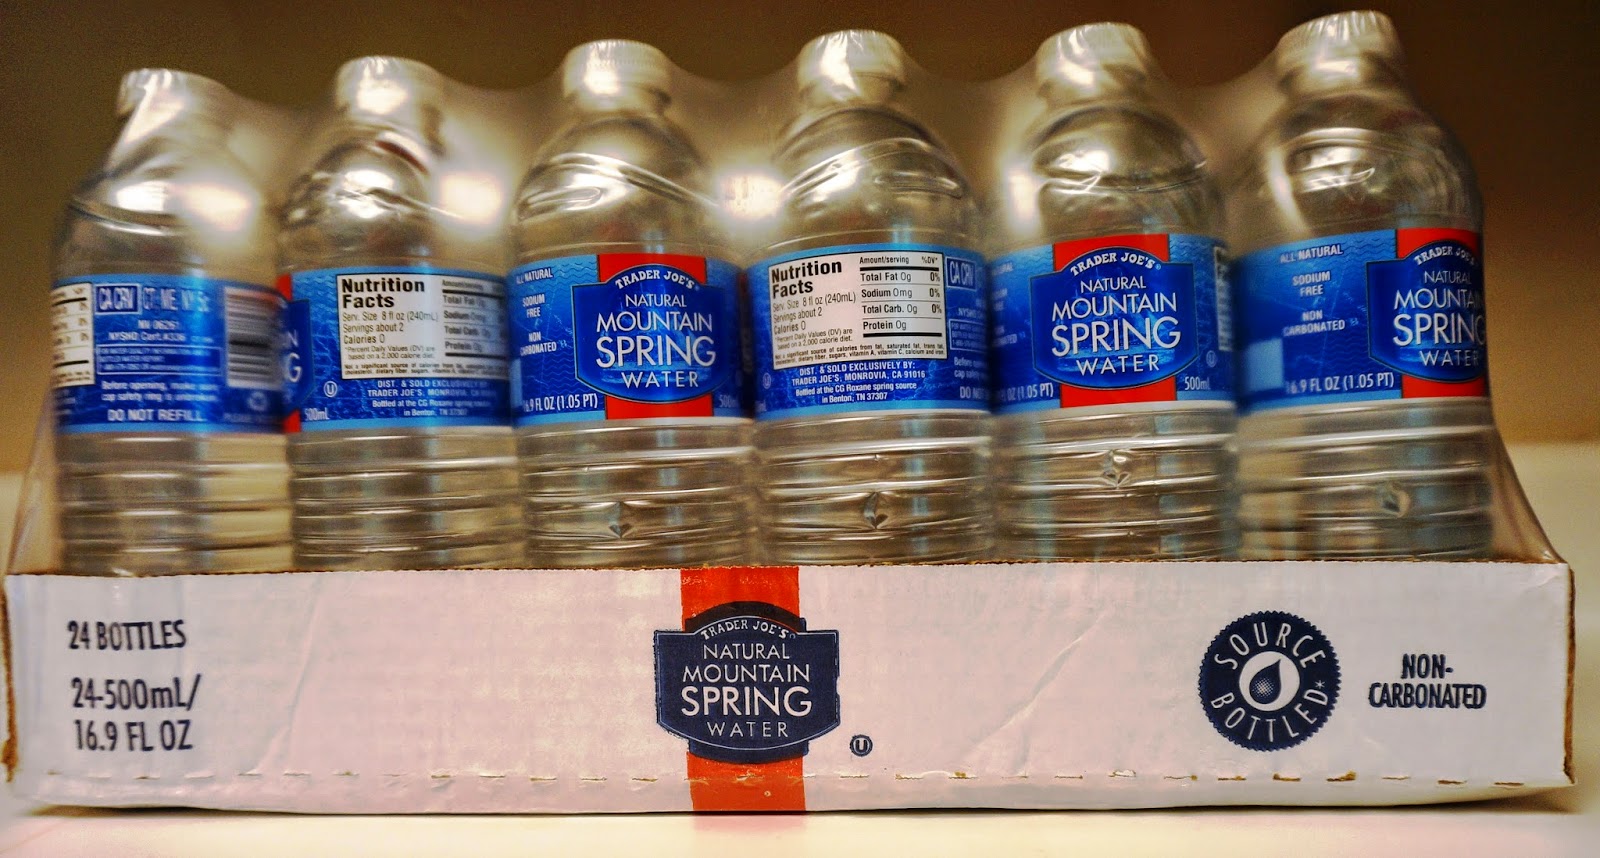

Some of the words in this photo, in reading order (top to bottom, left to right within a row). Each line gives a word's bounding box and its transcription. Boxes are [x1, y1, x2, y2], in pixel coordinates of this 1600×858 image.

[859, 256, 910, 265] Amount/serving
[1280, 251, 1298, 264] ALL
[1298, 244, 1344, 261] NATURAL
[1413, 246, 1453, 266] TRADER
[771, 260, 842, 284] Nutrition
[1069, 252, 1117, 277] TRADER
[1120, 251, 1155, 270] JOE'S
[524, 267, 553, 282] NATURAL
[615, 269, 661, 290] TRADER
[663, 270, 695, 290] JOE'S
[860, 272, 882, 281] Total
[885, 272, 898, 281] Fat
[900, 271, 912, 282] 0g
[930, 272, 940, 282] 0%
[949, 260, 960, 285] CA
[1292, 270, 1331, 286] SODIUM
[1424, 270, 1472, 285] NATURAL
[341, 277, 425, 293] Nutrition
[772, 280, 813, 299] Facts
[861, 289, 891, 298] Sodium
[893, 287, 913, 298] 0mg
[929, 287, 940, 298] 0%
[1080, 275, 1147, 294] NATURAL
[1300, 284, 1324, 297] FREE
[342, 294, 395, 309] Facts
[522, 293, 546, 307] SODIUM
[625, 293, 687, 308] NATURAL
[786, 299, 800, 309] Size
[802, 296, 807, 307] 8
[808, 295, 814, 306] fl
[814, 296, 823, 306] oz
[824, 291, 857, 307] (240mL)
[1051, 292, 1178, 322] MOUNTAIN
[362, 311, 378, 321] Size
[381, 311, 387, 321] 8
[396, 312, 405, 321] oz
[406, 310, 439, 322] (240mL)
[526, 306, 541, 318] FREE
[773, 312, 797, 324] Servings
[797, 308, 817, 319] about
[817, 306, 823, 317] 2
[862, 305, 882, 314] Total
[883, 304, 905, 313] Carb.
[906, 303, 918, 314] 0g
[931, 303, 942, 314] 0%
[1302, 309, 1323, 321] NON
[343, 323, 374, 334] Servings
[375, 323, 397, 332] about
[399, 322, 404, 332] 2
[596, 311, 713, 333] MOUNTAIN
[774, 322, 799, 335] Calories
[800, 320, 807, 331] 0
[863, 320, 893, 330] Protein
[895, 320, 907, 331] 0g
[1283, 320, 1345, 337] CARBONATED
[343, 335, 377, 344] Calories
[379, 333, 386, 344] 0
[528, 331, 542, 342] NON
[1051, 315, 1182, 357] SPRING
[520, 341, 557, 356] CARBONATED
[596, 334, 716, 368] SPRING
[849, 349, 870, 357] vitamin
[1075, 353, 1160, 376] WATER
[1419, 349, 1480, 367] WATER
[799, 366, 818, 376] DIST.
[819, 365, 825, 374] &
[827, 363, 847, 373] SOLD
[849, 361, 901, 372] EXCLUSIVELY
[902, 361, 916, 369] BY:
[377, 380, 399, 388] DIST.
[409, 380, 430, 388] SOLD
[621, 370, 699, 389] WATER
[791, 377, 817, 386] TRADER
[891, 371, 902, 379] CA
[903, 370, 926, 379] 91016
[1184, 376, 1211, 391] 500mL
[1309, 376, 1322, 392] FL
[1325, 375, 1341, 391] OZ
[1343, 373, 1374, 392] (1.05
[1376, 371, 1395, 388] PT)
[367, 389, 399, 397] TRADER
[795, 387, 816, 397] Bottled
[823, 385, 834, 393] the
[834, 384, 845, 392] CG
[846, 383, 872, 392] Roxane
[872, 381, 895, 392] spring
[895, 382, 917, 390] source
[855, 392, 866, 401] TN
[866, 391, 888, 400] 37307
[1040, 382, 1054, 398] PT)
[405, 399, 417, 407] the
[417, 399, 428, 407] CG
[535, 397, 543, 411] FL
[544, 395, 556, 411] OZ
[556, 394, 581, 411] (1.05
[582, 392, 598, 409] PT)
[719, 394, 739, 408] 500m
[107, 408, 125, 422] DO
[127, 408, 155, 422] NOT
[157, 408, 207, 422] REFILL
[68, 621, 91, 651] 24
[96, 619, 187, 651] BOTTLES
[701, 619, 749, 640] TRADER
[752, 620, 788, 639] JOE'S
[703, 643, 790, 660] NATURAL
[1214, 621, 1327, 670] SOURCE
[682, 663, 810, 683] MOUNTAIN
[1401, 653, 1454, 680] NON-
[71, 673, 202, 711] 24-500mL/
[1368, 682, 1488, 709] CARBONATED
[681, 685, 813, 717] SPRING
[74, 720, 117, 752] 16.9
[128, 720, 155, 752] FL
[160, 720, 194, 752] OZ
[706, 721, 789, 738] WATER
